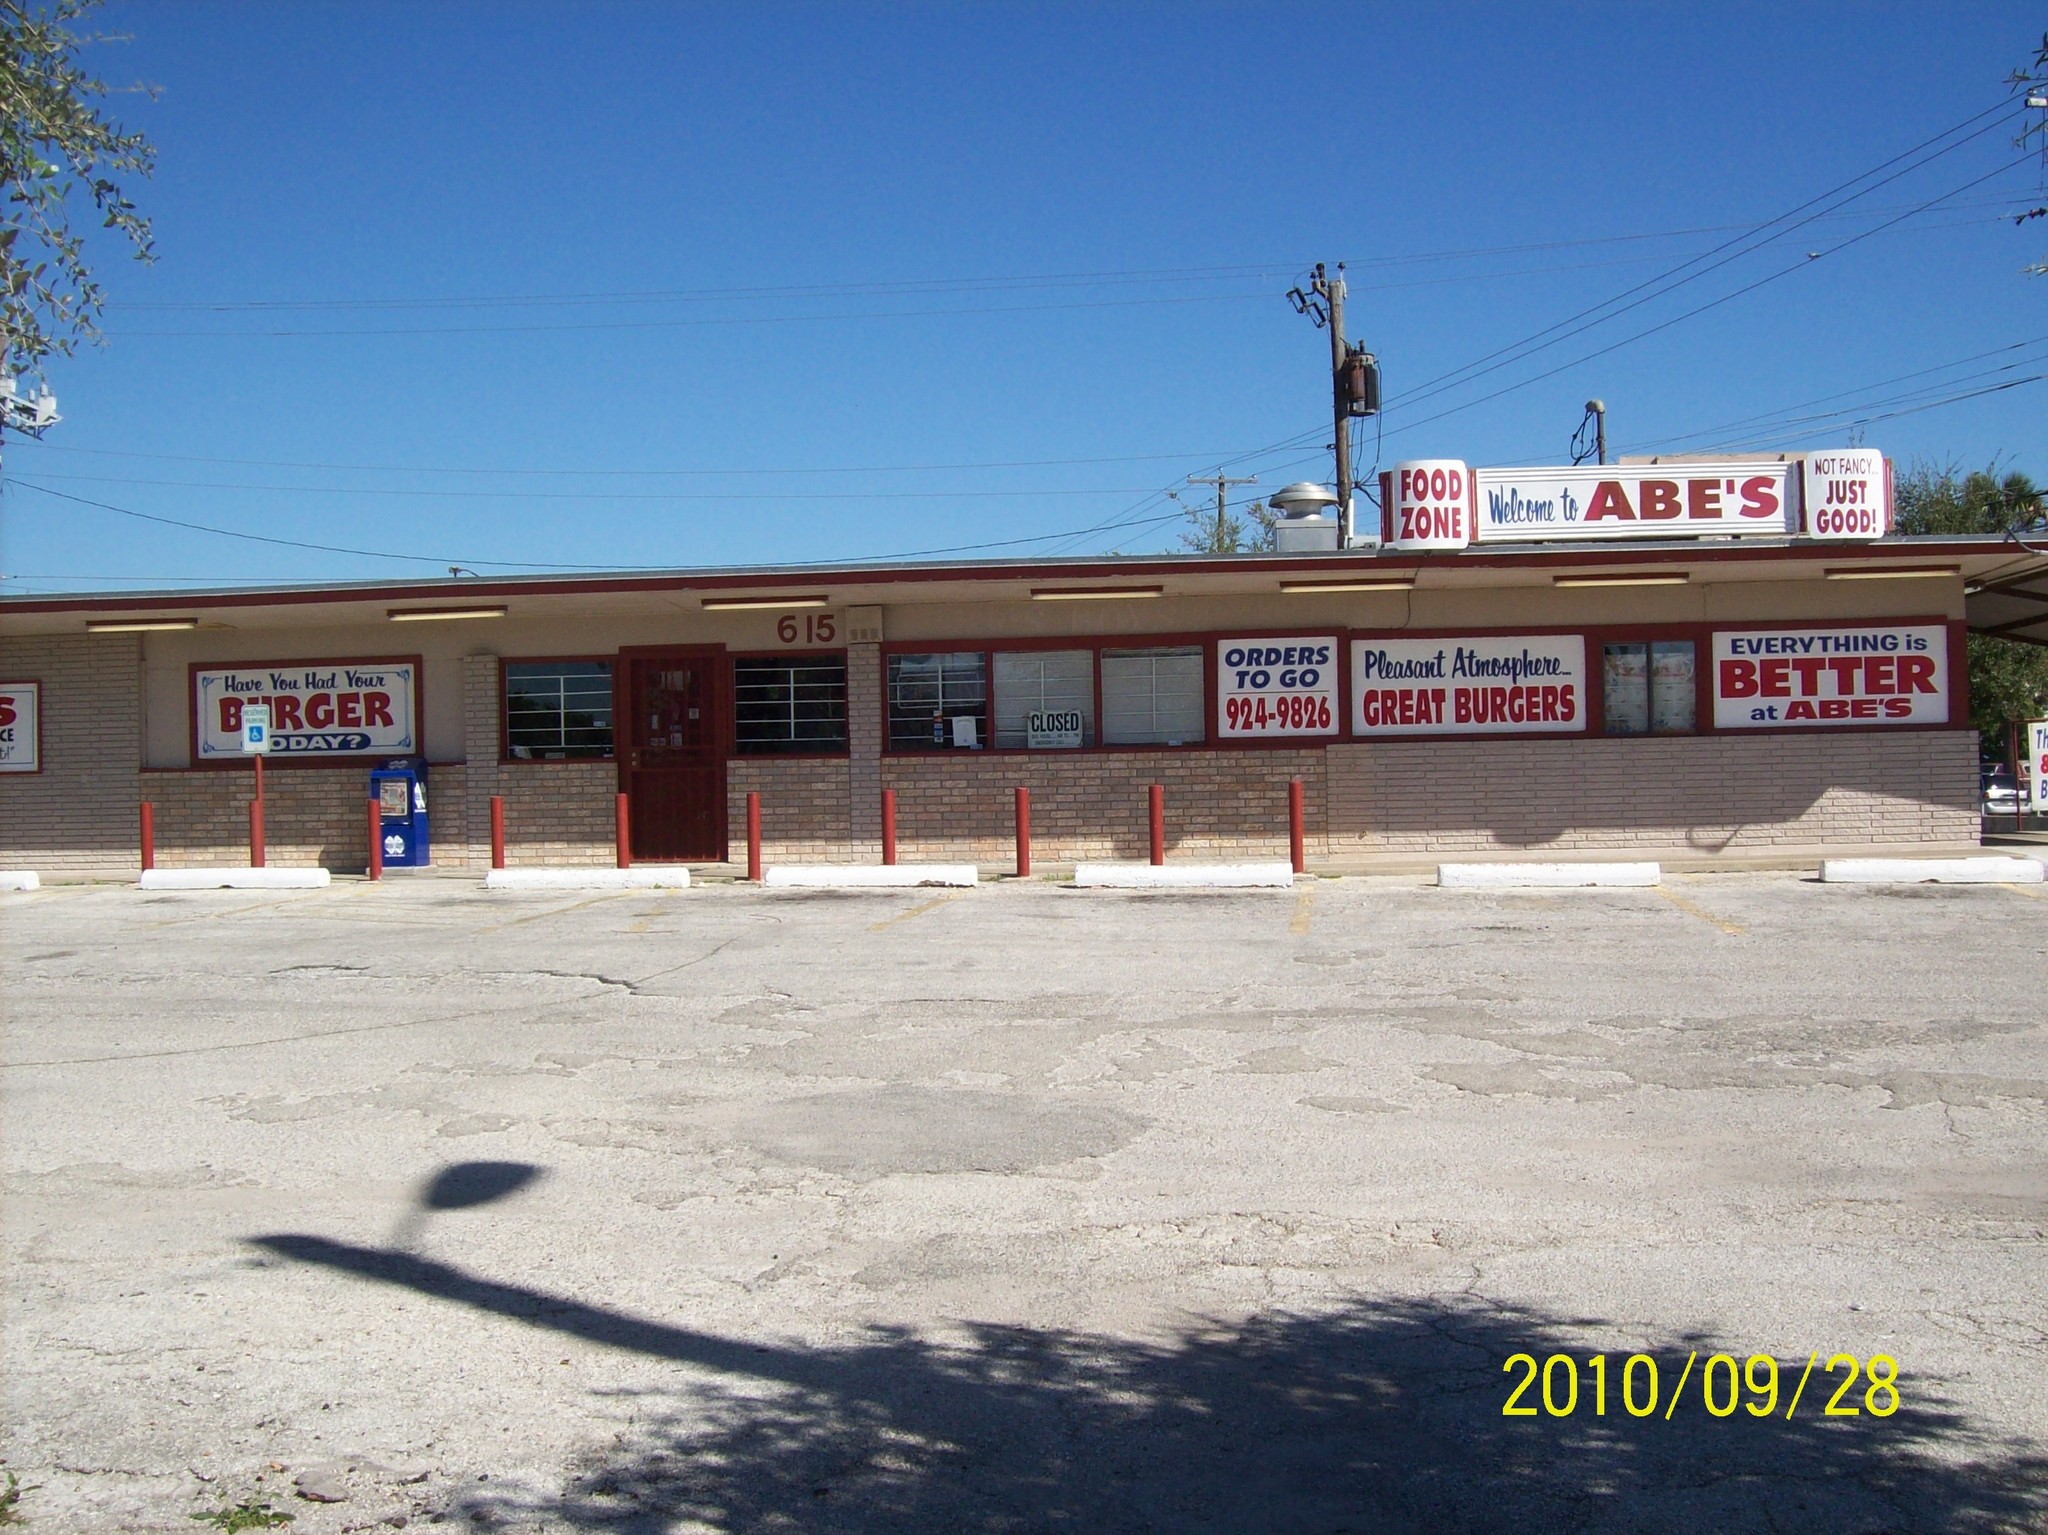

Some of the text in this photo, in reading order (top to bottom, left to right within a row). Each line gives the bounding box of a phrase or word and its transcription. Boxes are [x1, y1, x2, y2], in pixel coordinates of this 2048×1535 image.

[1815, 458, 1836, 475] NOT
[1401, 468, 1462, 502] FOOD
[1826, 480, 1867, 504] JUST
[1488, 476, 1779, 524] Welcome to ABE'S
[1400, 506, 1461, 539] ZONE
[1817, 508, 1876, 533] GOOD!
[777, 614, 835, 643] 615
[1731, 634, 1927, 654] EVERYTHING is
[1225, 646, 1330, 667] ORDERS
[1365, 650, 1446, 679] Pleasant
[224, 670, 385, 692] Have You Had Your
[1235, 668, 1320, 689] TO GO
[1720, 655, 1938, 698] BETTER
[1226, 696, 1331, 730] 924-9826
[1364, 684, 1575, 726] GREAT BURGERS
[1751, 698, 1912, 720] at ABE'S
[1031, 713, 1079, 732] CLOSED
[271, 735, 362, 749] ODAY?
